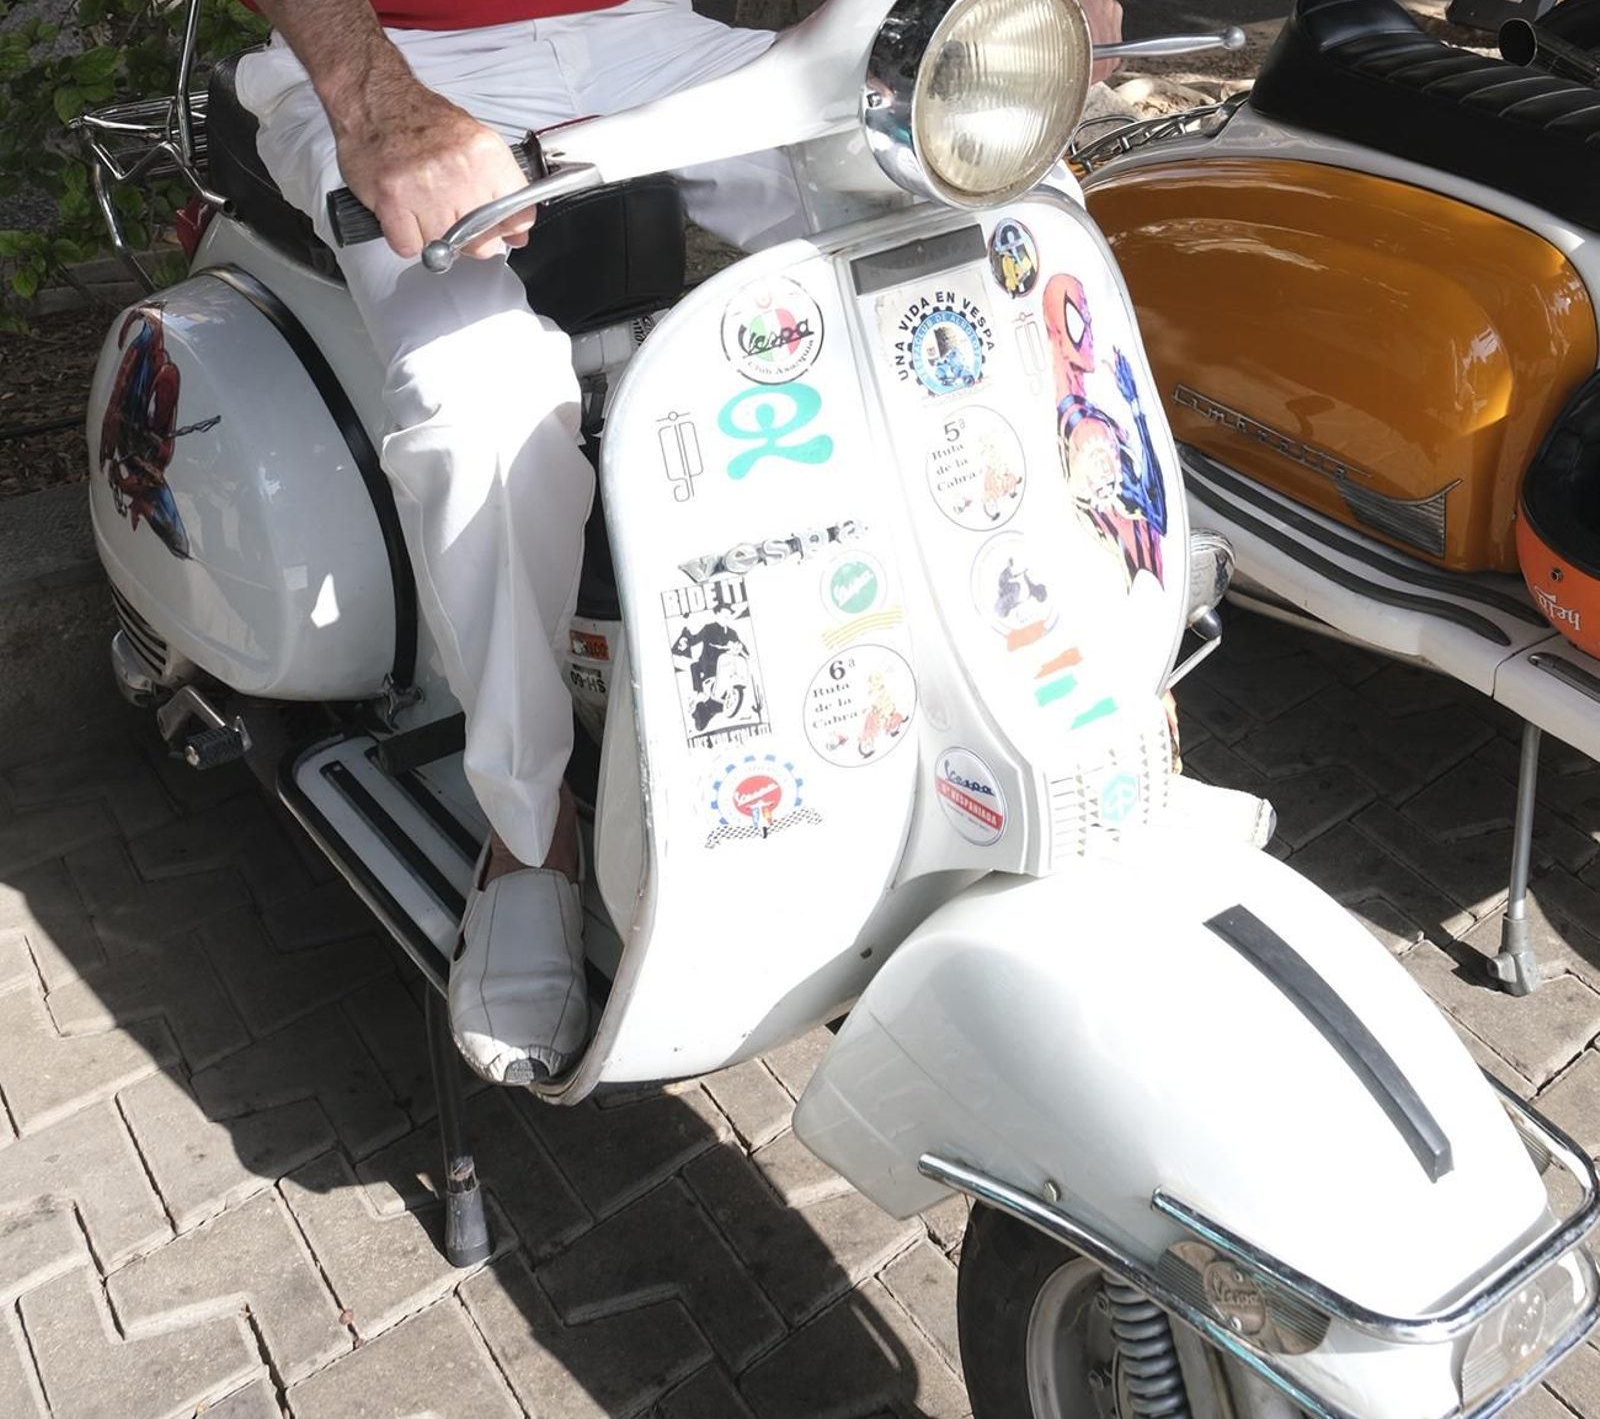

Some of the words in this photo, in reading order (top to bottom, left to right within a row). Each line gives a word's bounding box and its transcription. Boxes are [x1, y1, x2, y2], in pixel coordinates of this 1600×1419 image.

[935, 291, 955, 303] EN
[898, 297, 930, 332] VIDA
[962, 298, 995, 350] VESPA
[738, 319, 815, 359] Vespa
[895, 341, 909, 381] UNA
[932, 444, 964, 460] Ruta
[937, 465, 951, 475] de
[956, 459, 968, 467] la
[937, 472, 976, 491] Cabra
[662, 583, 720, 618] RIDE
[720, 577, 748, 604] IT
[813, 683, 850, 698] Ruta
[815, 703, 832, 713] de
[838, 698, 852, 706] la
[813, 712, 858, 728] Cabra
[944, 759, 996, 798] Vespa
